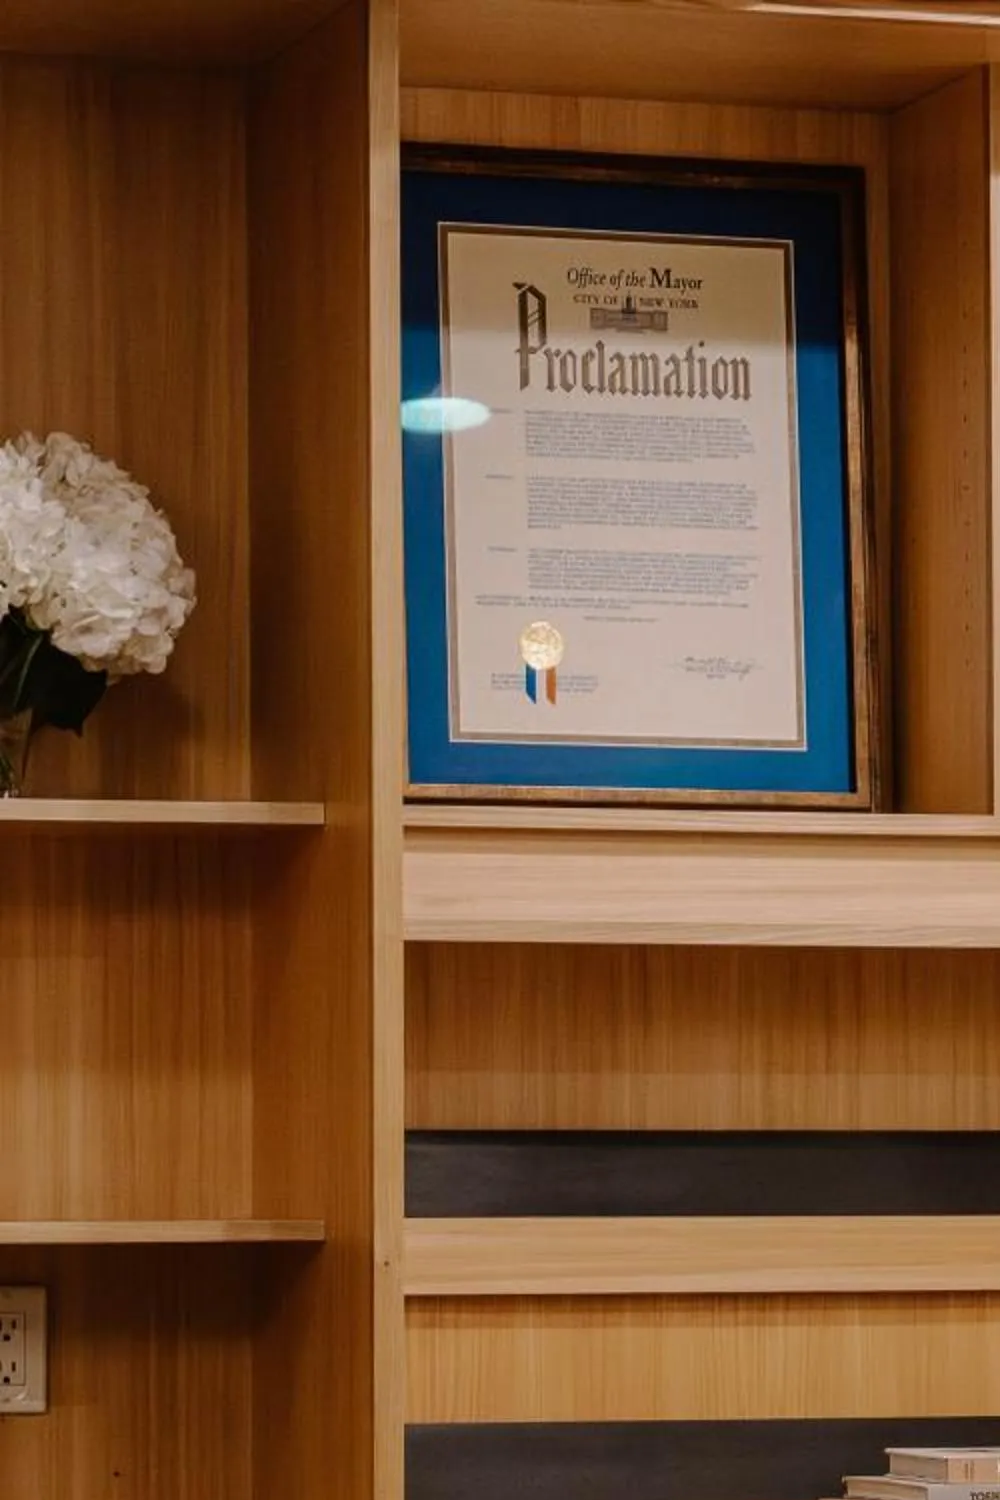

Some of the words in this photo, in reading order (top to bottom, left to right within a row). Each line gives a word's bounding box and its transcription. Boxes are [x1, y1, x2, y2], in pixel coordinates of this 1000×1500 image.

[567, 267, 606, 289] Office
[609, 270, 625, 290] of
[625, 270, 646, 289] the
[650, 267, 704, 294] Mayor
[512, 282, 752, 401] Proclamation
